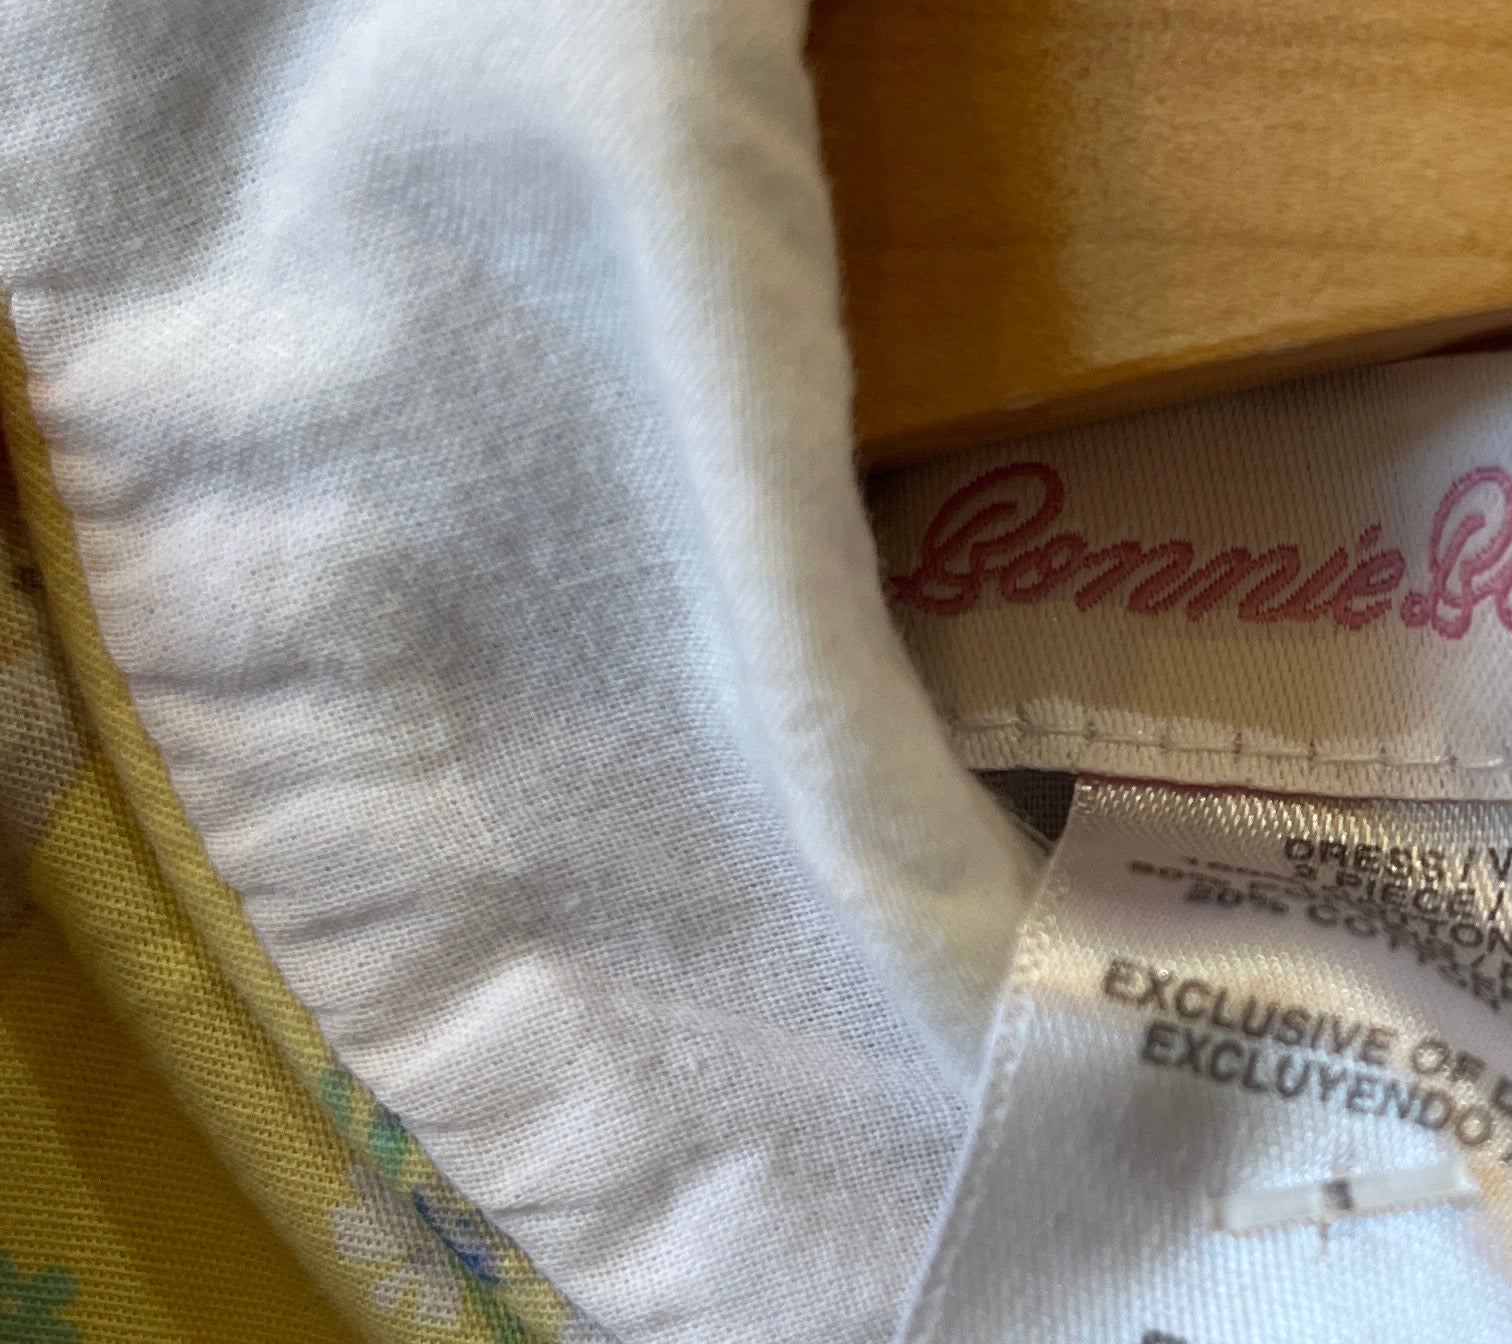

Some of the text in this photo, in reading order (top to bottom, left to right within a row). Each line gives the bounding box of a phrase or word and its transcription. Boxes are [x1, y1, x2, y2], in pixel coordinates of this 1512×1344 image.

[887, 460, 1399, 631] Bonnie
[1284, 837, 1446, 883] DRESS
[1335, 869, 1477, 923] PIECE
[1103, 957, 1399, 1067] EXCLUSIVE
[1410, 1034, 1487, 1084] OF
[1141, 1018, 1493, 1147] EXCLUYENDO
